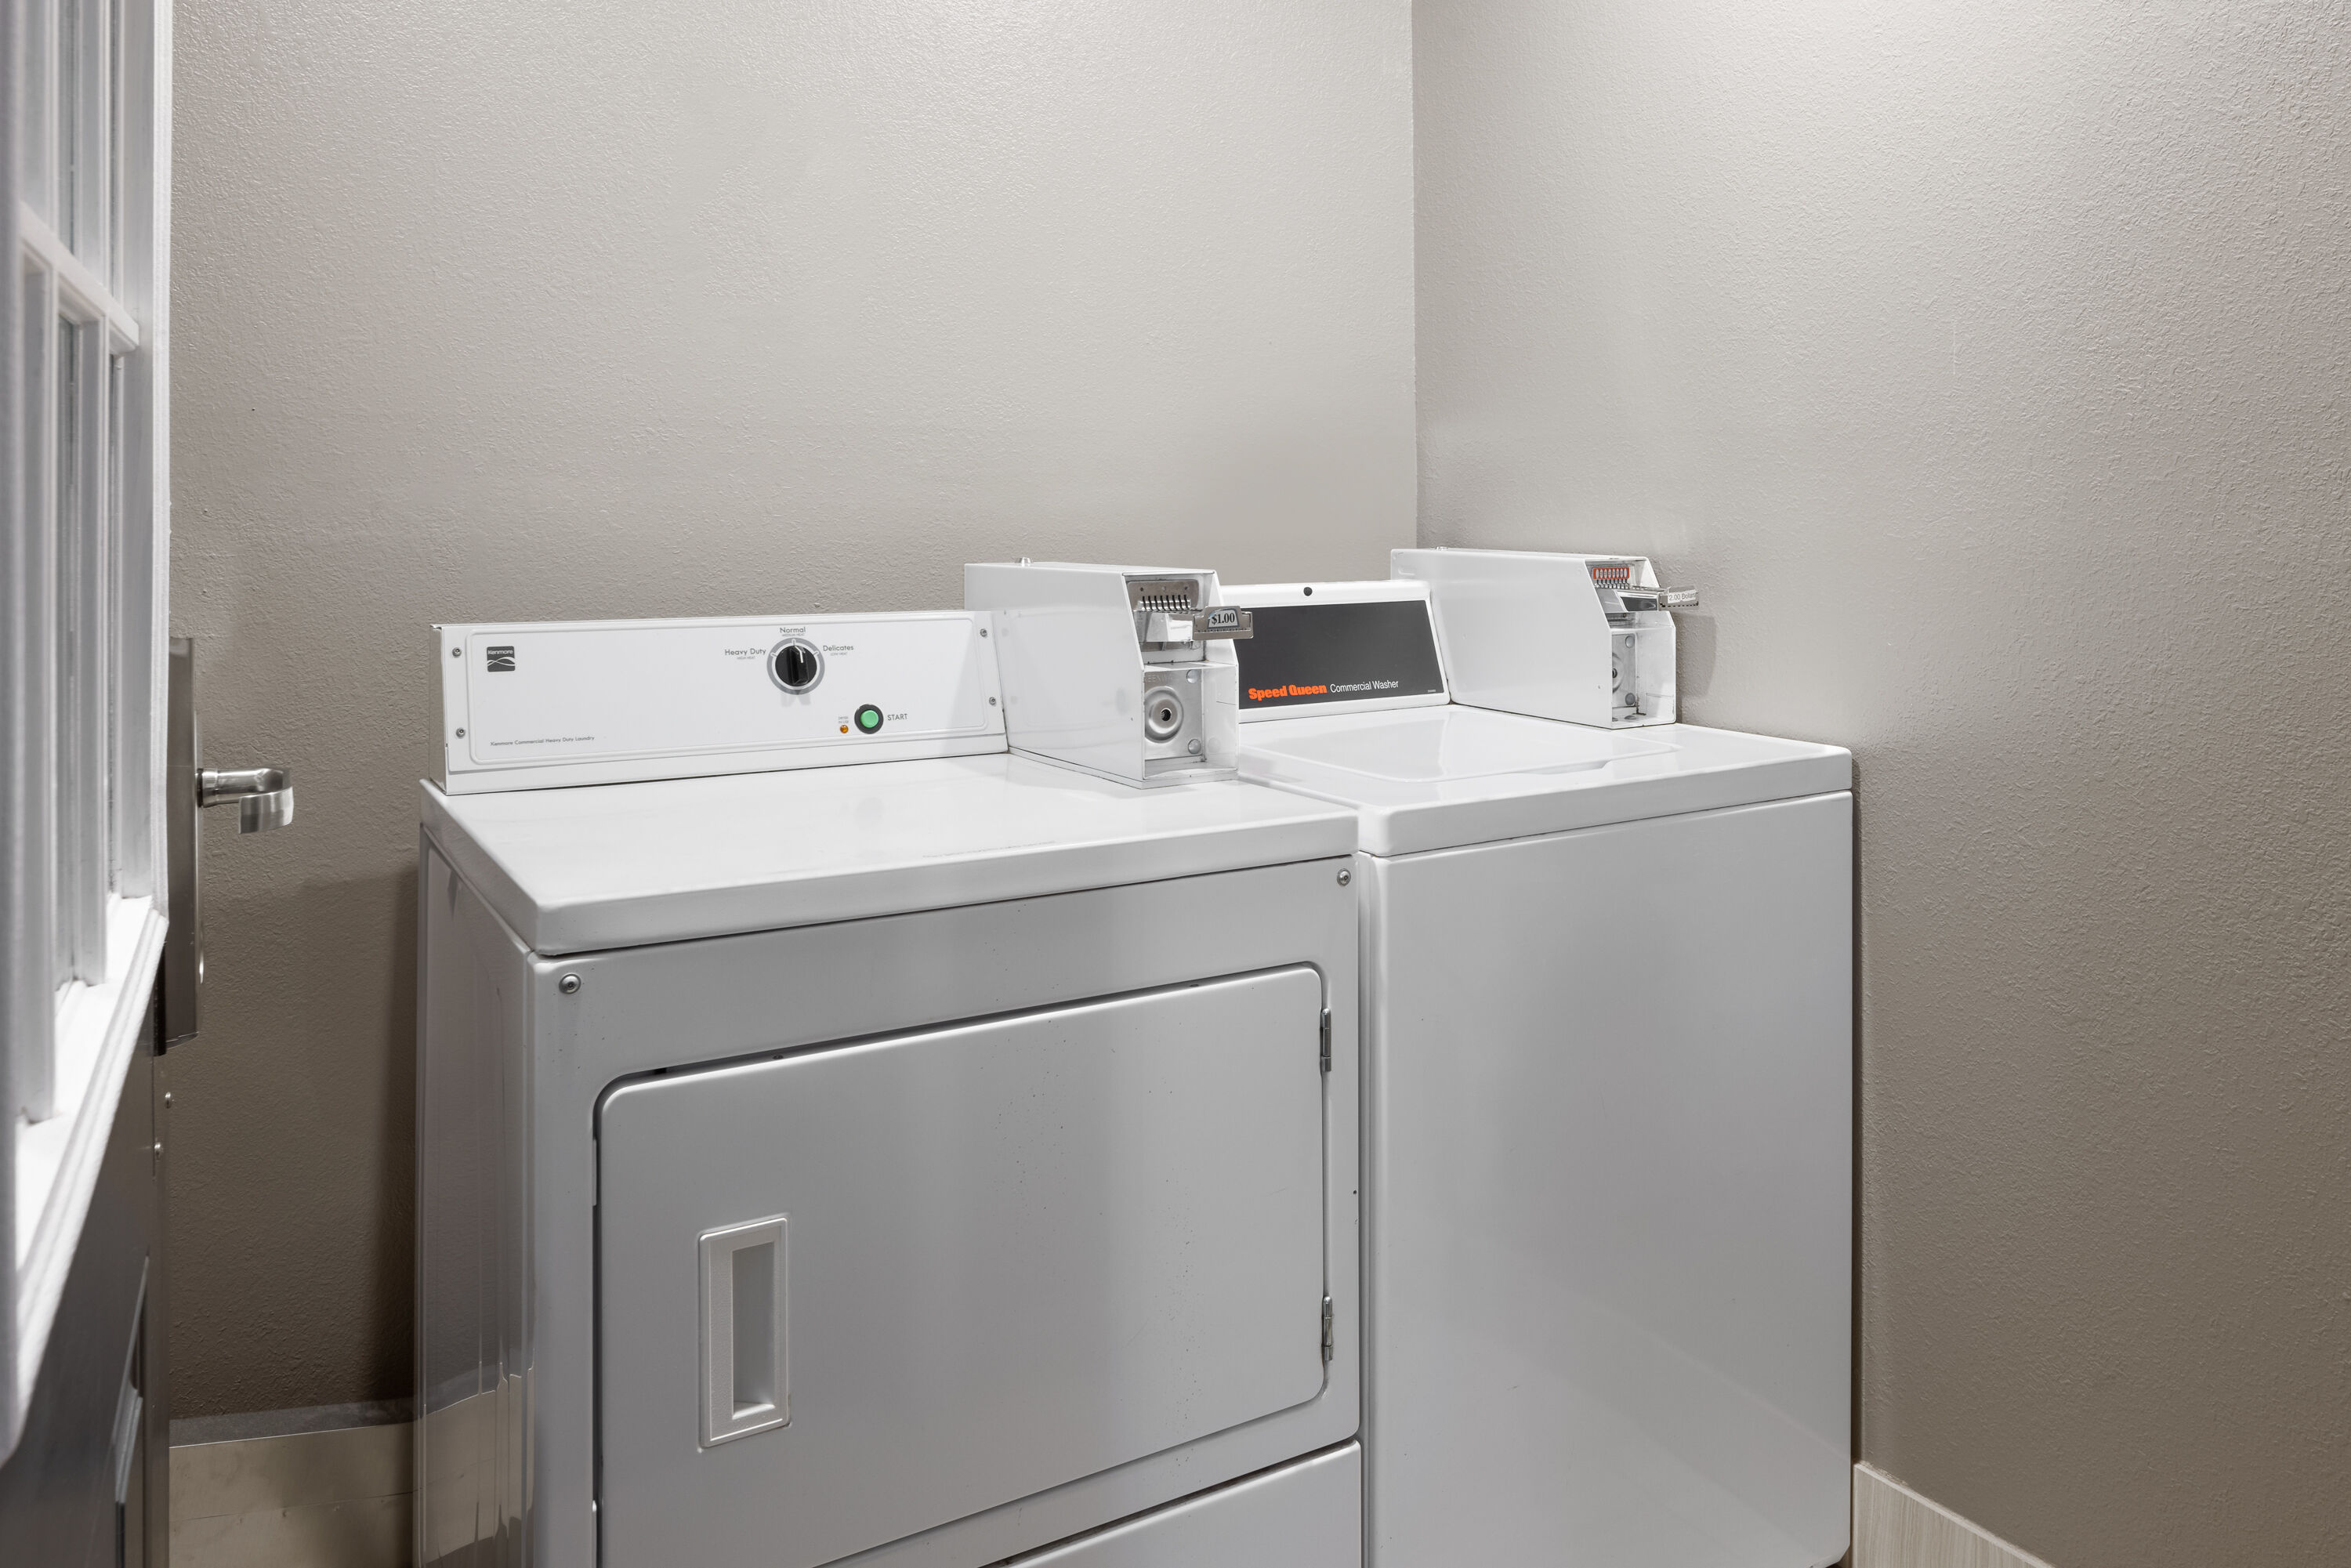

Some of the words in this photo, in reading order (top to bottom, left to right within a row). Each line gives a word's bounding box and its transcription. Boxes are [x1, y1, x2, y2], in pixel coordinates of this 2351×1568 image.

[1212, 612, 1235, 625] $1.00
[1248, 684, 1287, 701] Speed
[1288, 683, 1328, 697] Queen
[1330, 681, 1372, 693] Commercial
[1373, 679, 1399, 690] Washer
